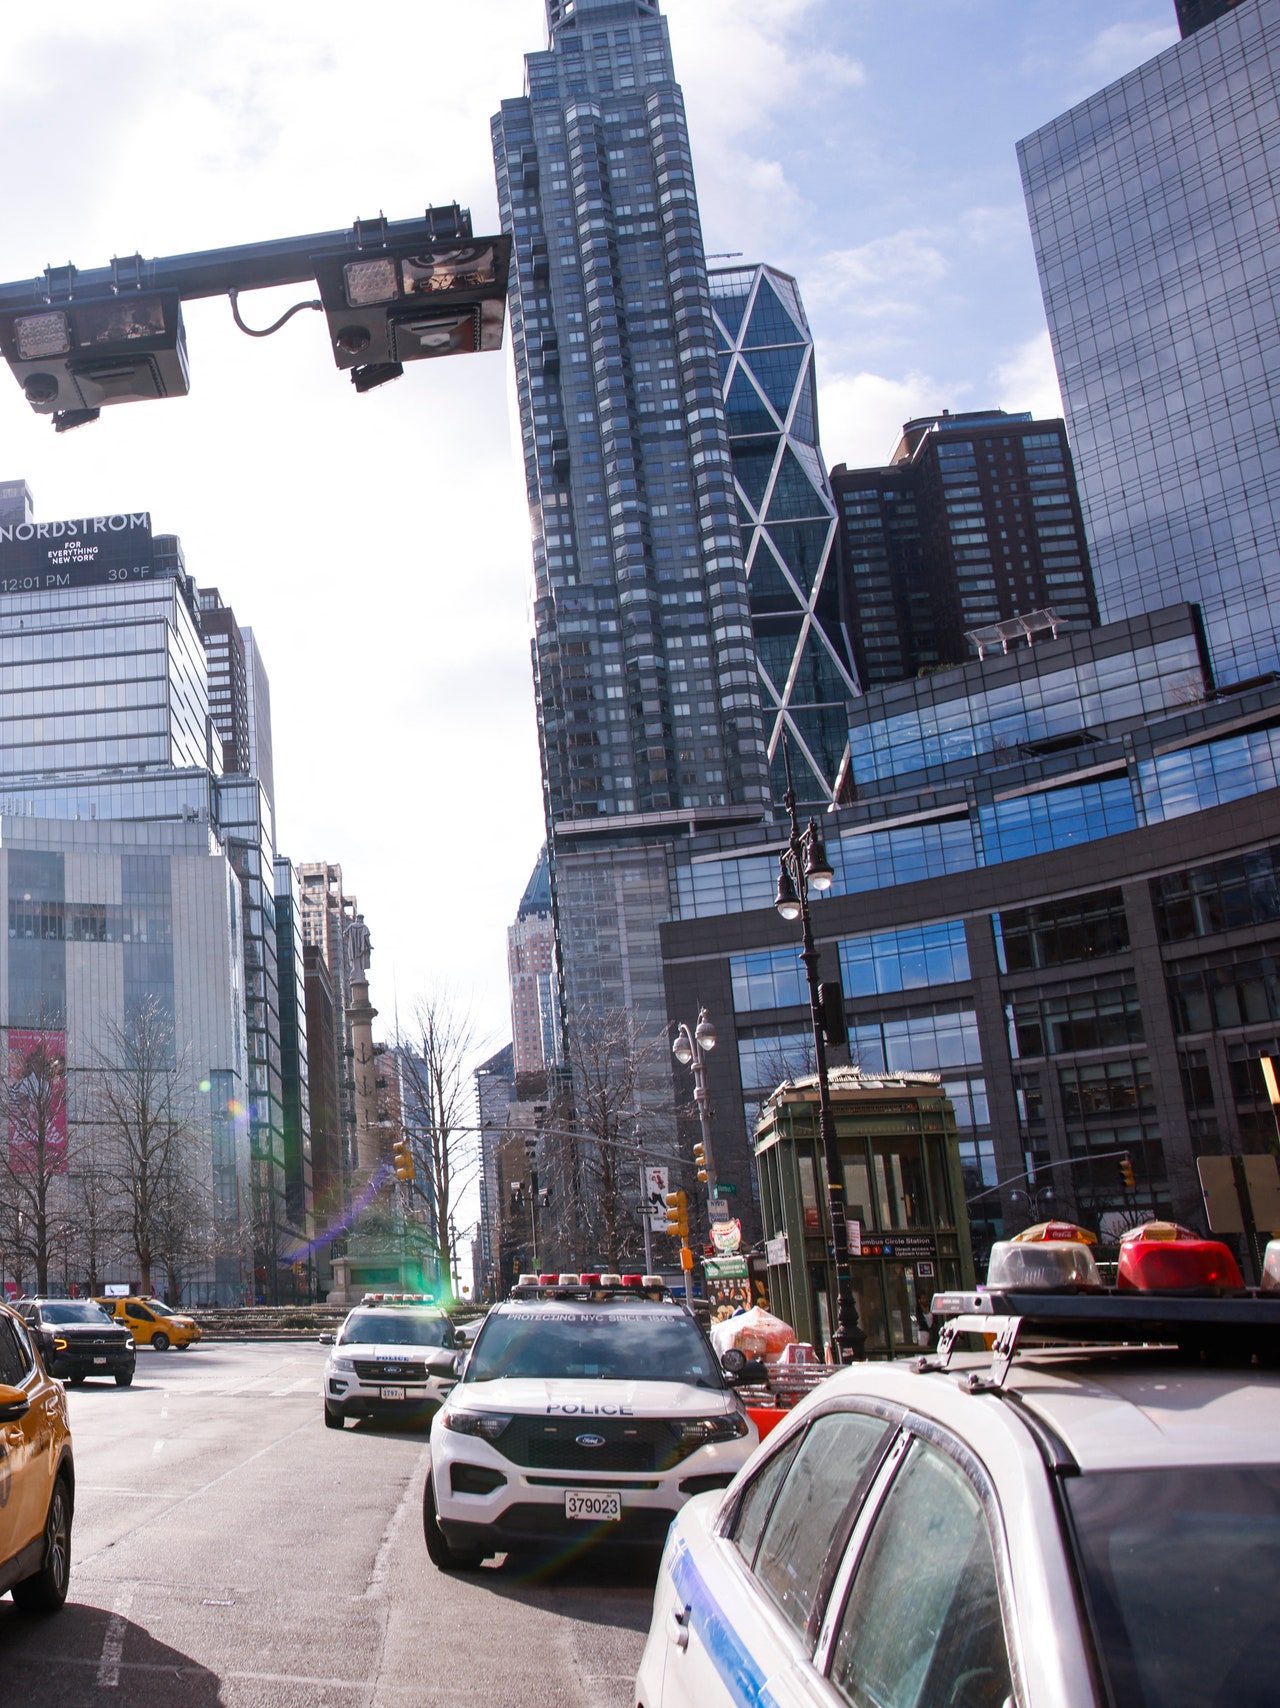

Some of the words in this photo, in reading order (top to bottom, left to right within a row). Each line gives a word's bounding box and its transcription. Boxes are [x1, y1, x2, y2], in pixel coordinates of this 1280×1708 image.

[64, 541, 81, 549] FOR
[47, 546, 99, 558] EVERYTHING
[52, 556, 70, 565] NEW
[72, 553, 94, 563] YORK
[108, 568, 128, 581] 30
[1, 576, 40, 591] 12:01
[46, 573, 70, 587] PM
[884, 1237, 905, 1245] Circle
[506, 1314, 576, 1322] PROTECTING
[580, 1314, 604, 1322] NYC
[546, 1403, 634, 1416] POLICE
[568, 1498, 618, 1514] 379023
